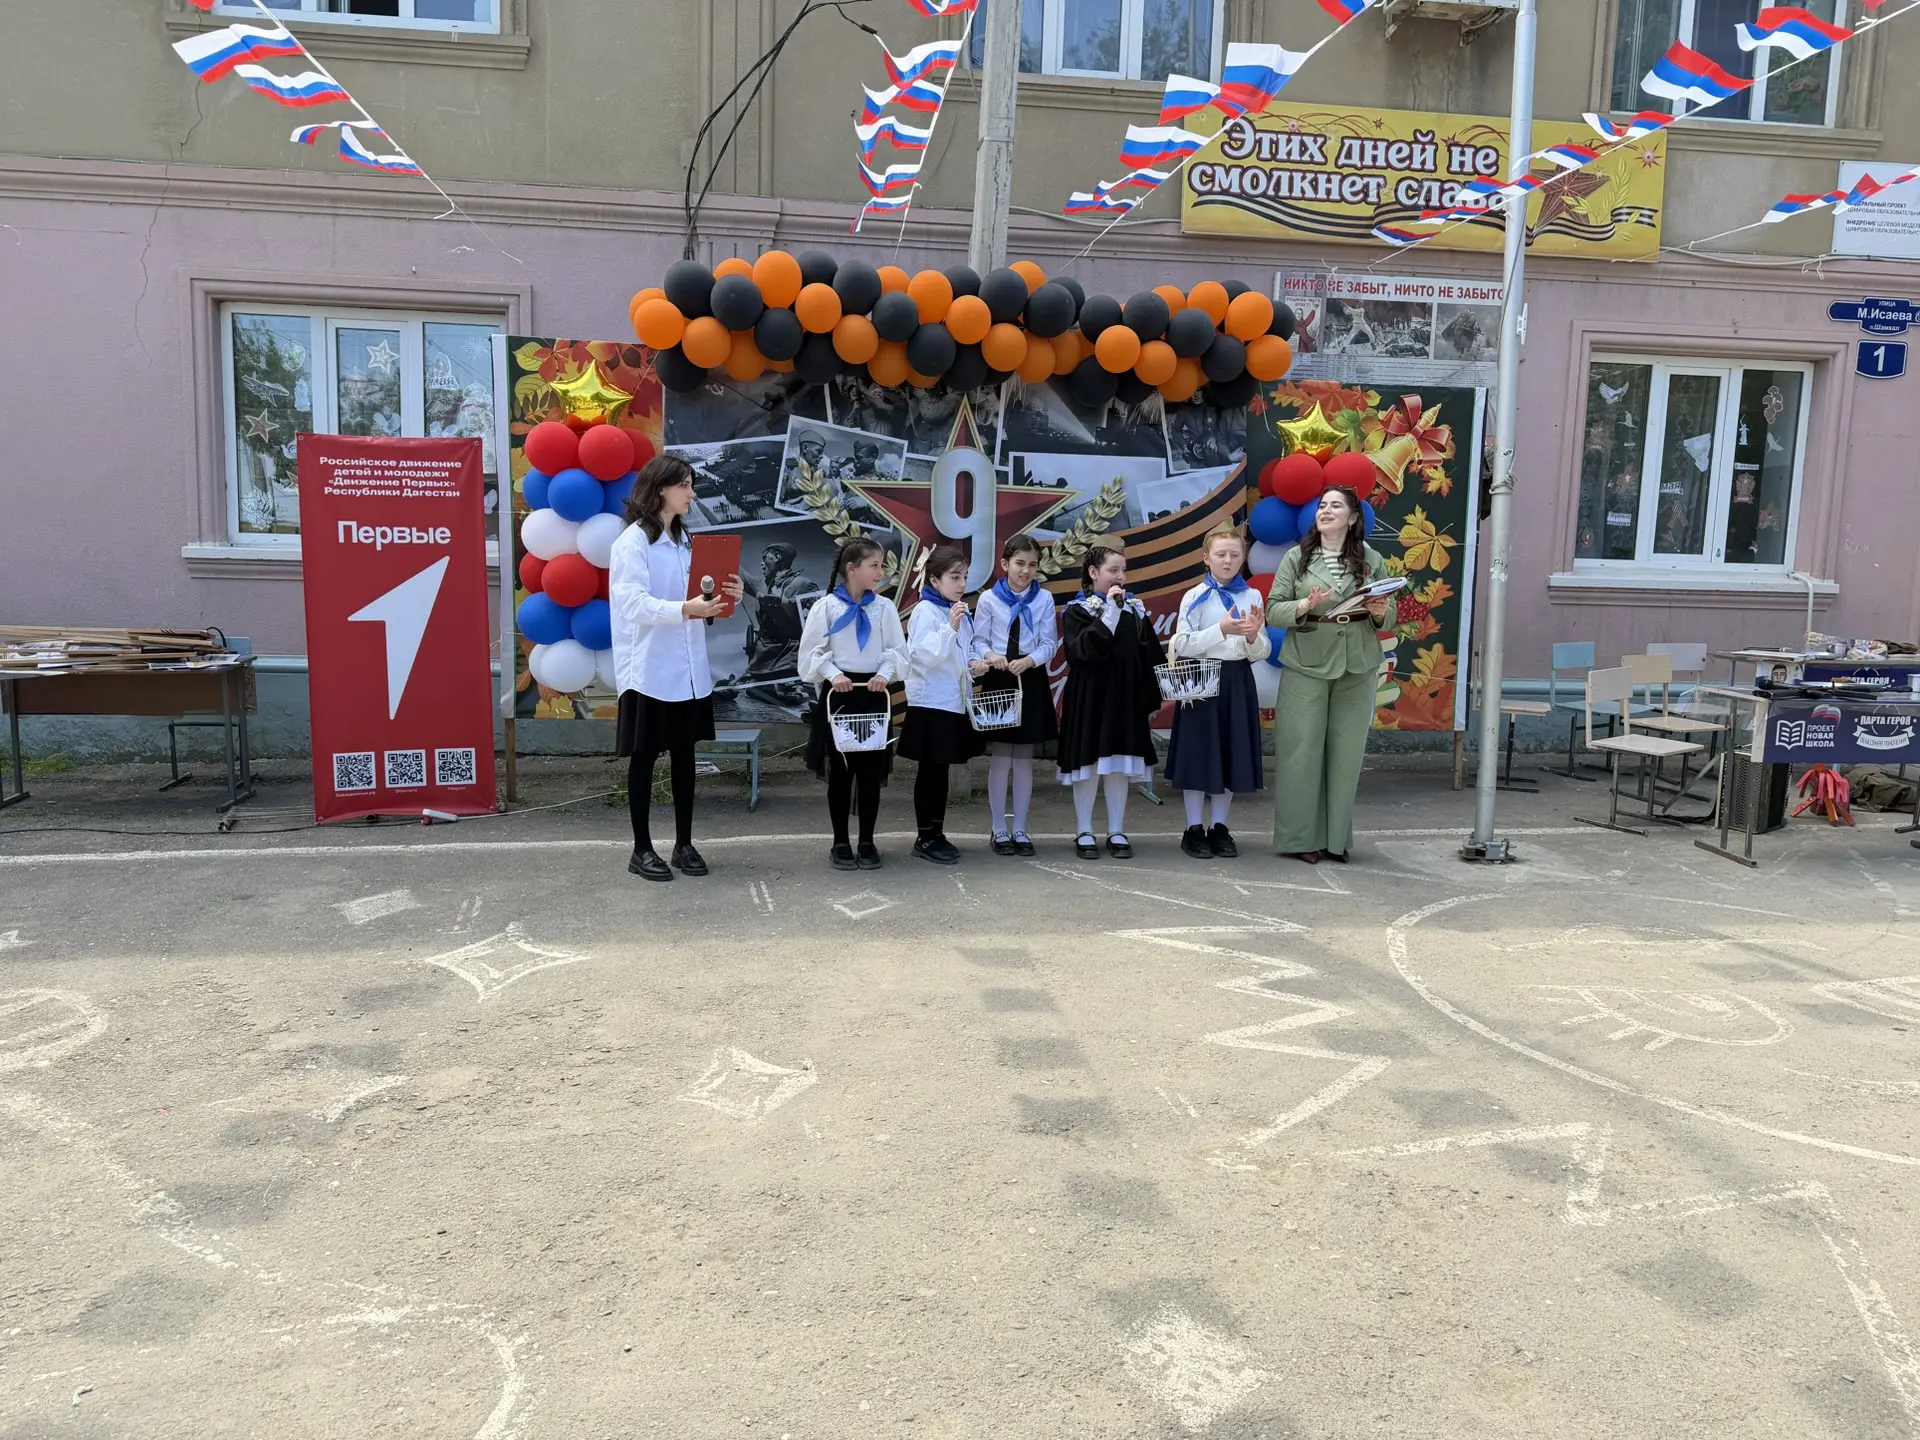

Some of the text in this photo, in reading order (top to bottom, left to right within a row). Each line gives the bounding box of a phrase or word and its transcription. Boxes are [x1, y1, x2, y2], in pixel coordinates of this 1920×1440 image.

[1221, 116, 1499, 176] Этих дней не
[1188, 161, 1386, 205] смолкнет
[1284, 278, 1324, 292] НИКТО
[1328, 280, 1343, 293] НЕ
[1347, 281, 1391, 297] ЗАБЫТ,
[1394, 283, 1434, 297] НИЧТО
[1438, 285, 1454, 298] НЕ
[1857, 307, 1912, 321] М.Исаева
[1873, 345, 1886, 372] 1
[319, 456, 462, 469] Российское движение
[333, 467, 371, 477] детей
[384, 469, 449, 478] молодежи
[328, 477, 456, 488] «Движение Первых»
[324, 487, 461, 498] Республики Дагестан
[931, 446, 997, 595] 9
[337, 520, 452, 551] Первые
[1867, 677, 1890, 685] ГЕРОЯ
[1860, 715, 1912, 726] ПАРТА ГЕРОЯ
[1807, 724, 1836, 732] ПРОЕКТ
[1806, 732, 1834, 740] НОВАЯ
[1805, 740, 1835, 748] ШКОЛА
